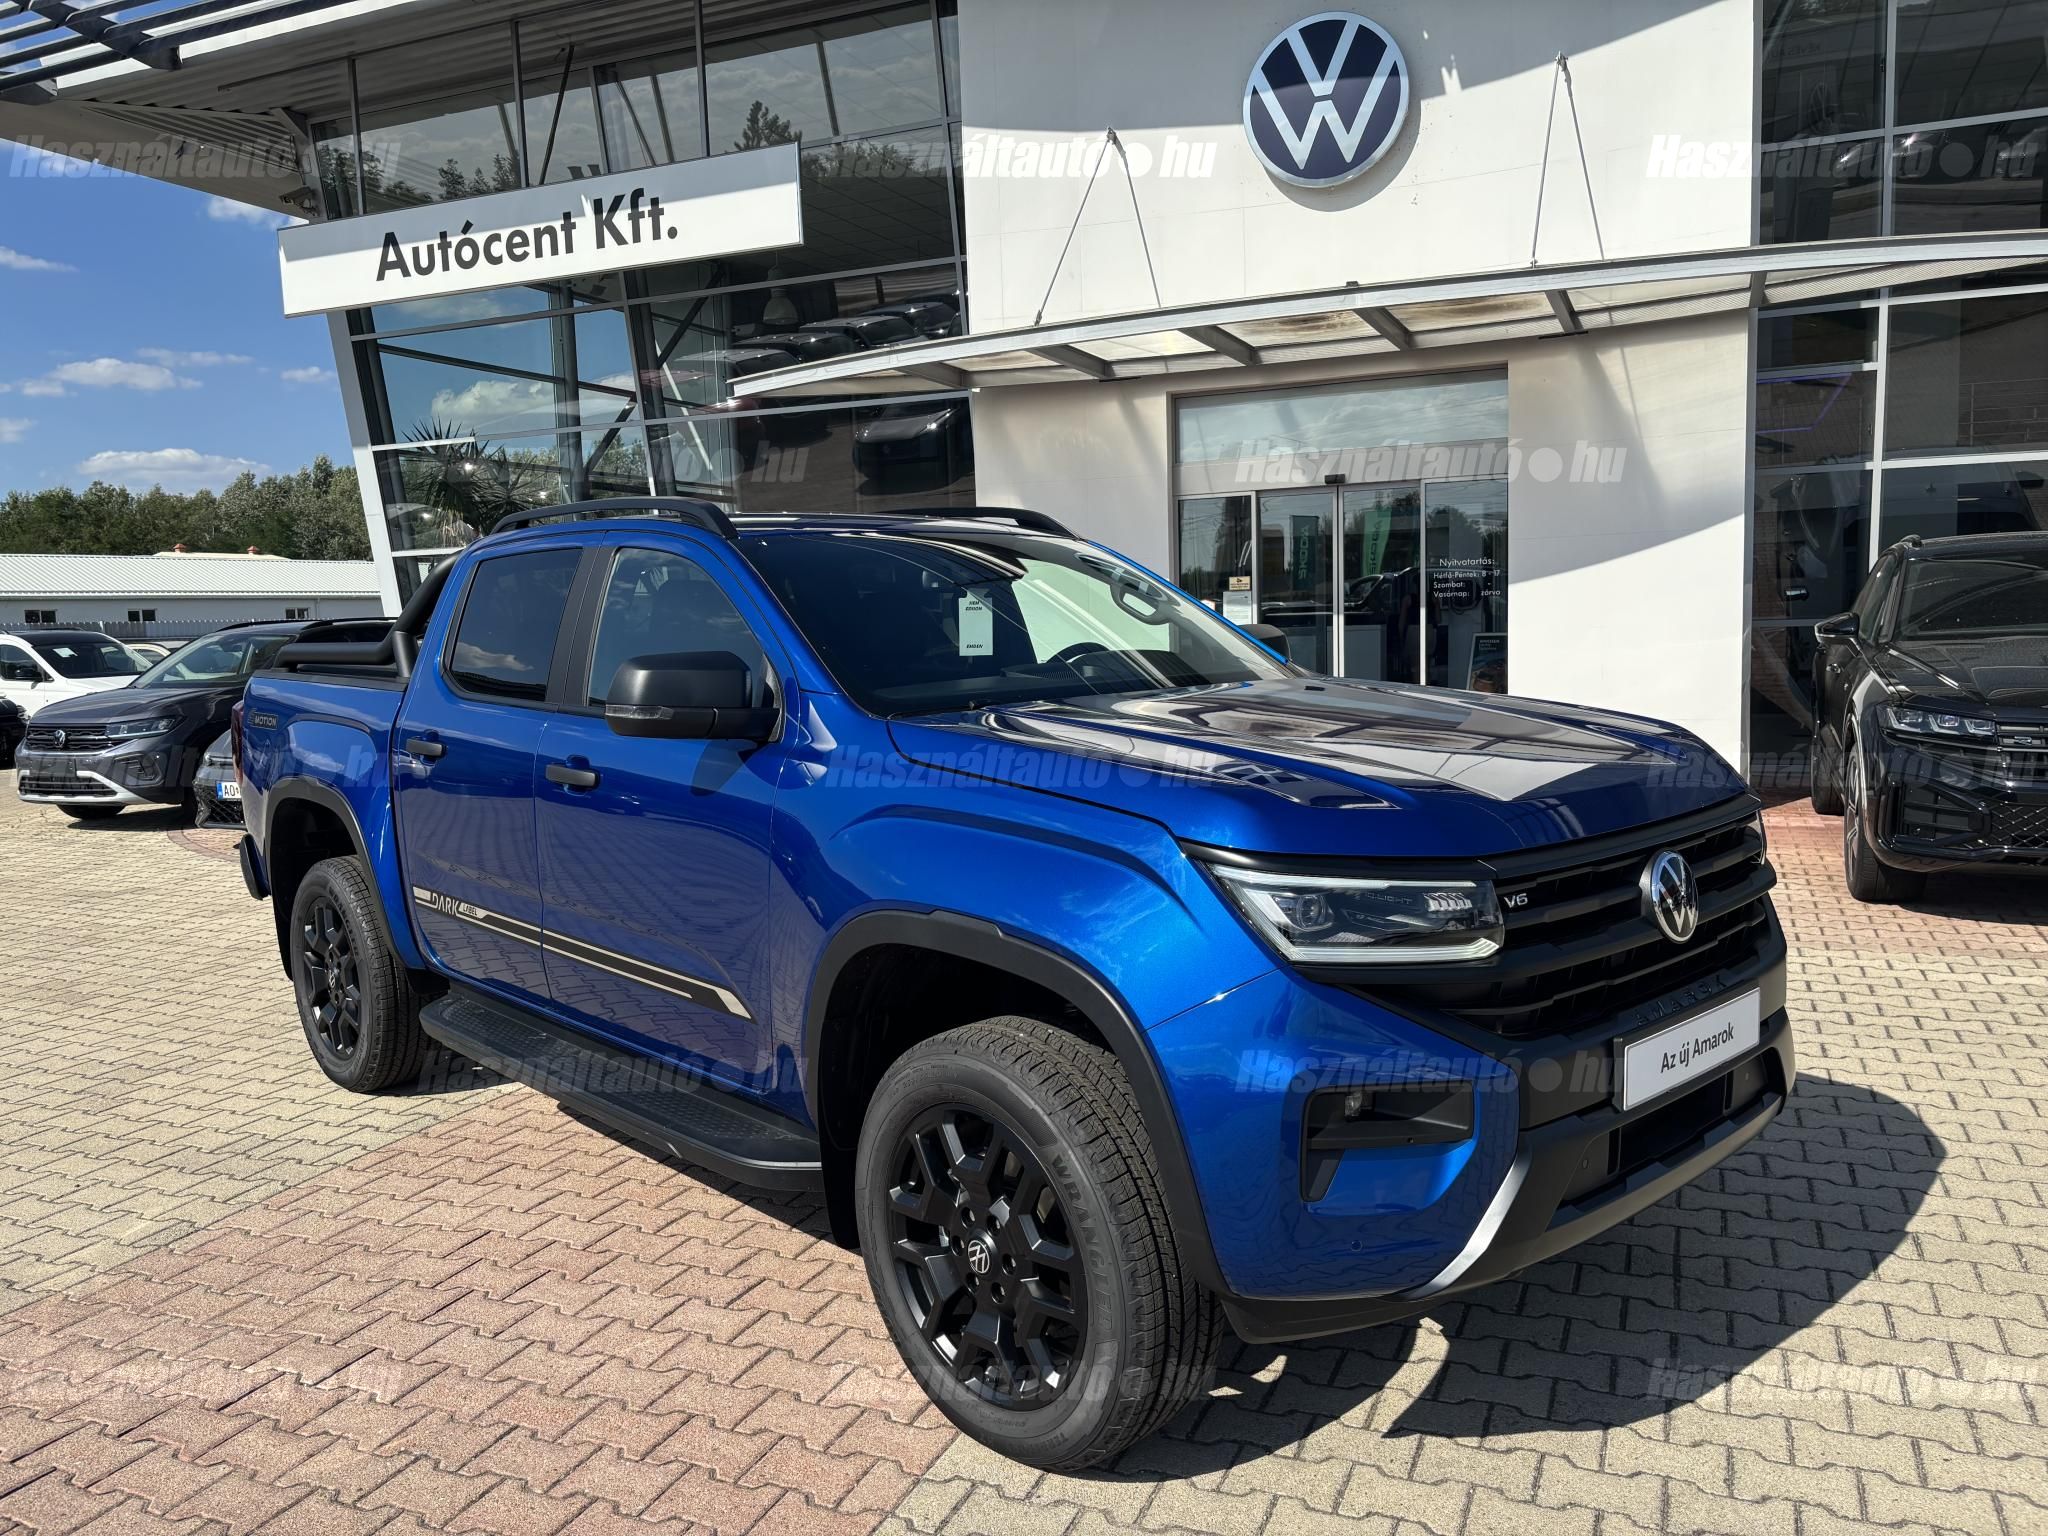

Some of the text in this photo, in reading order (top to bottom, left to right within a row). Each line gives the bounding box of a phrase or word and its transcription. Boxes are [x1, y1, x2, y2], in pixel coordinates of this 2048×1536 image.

[376, 188, 678, 282] Autócent Kft.
[1439, 557, 1495, 568] Nyitvatartás:
[432, 892, 459, 916] DARK
[1504, 892, 1528, 909] V6
[1660, 1023, 1734, 1073] Az új Amarok
